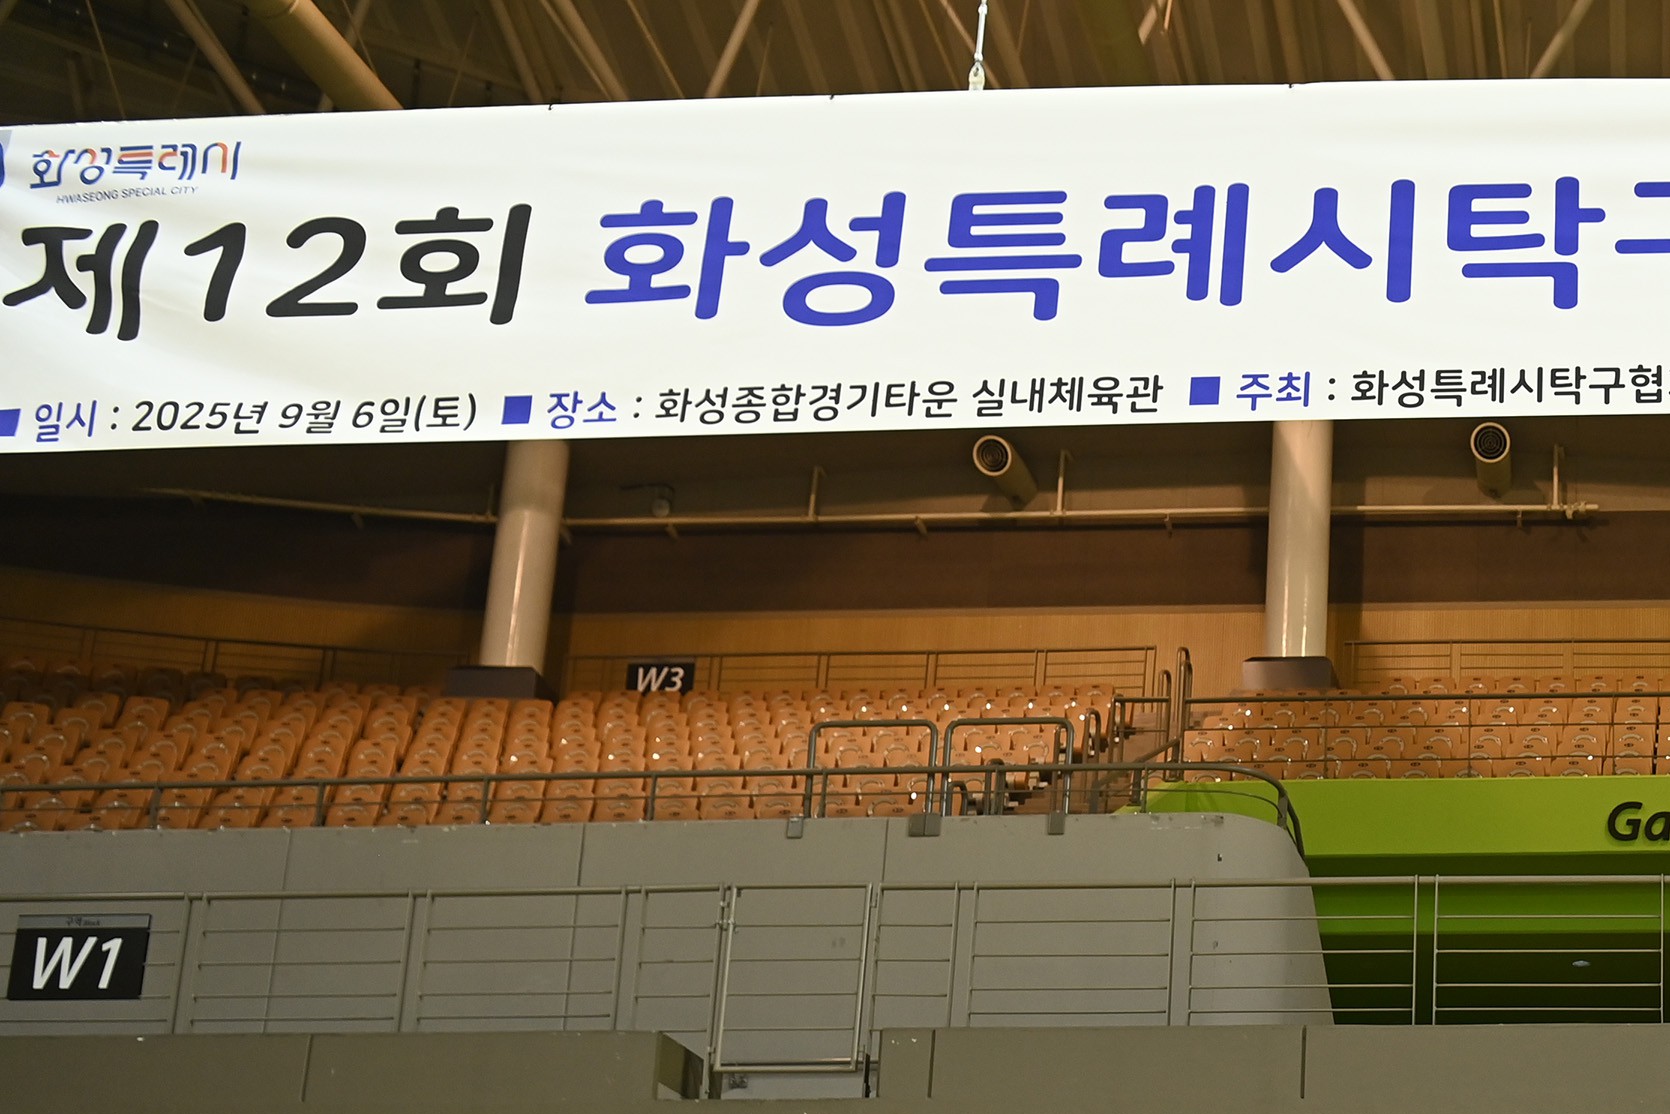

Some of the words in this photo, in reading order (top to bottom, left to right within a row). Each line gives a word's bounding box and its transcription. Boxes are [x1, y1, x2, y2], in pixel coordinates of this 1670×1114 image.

[56, 190, 119, 204] HWASEONG
[121, 186, 167, 199] SPECIAL
[170, 186, 198, 195] CITY
[3, 205, 532, 341] 제12회
[36, 401, 97, 442] 일시
[132, 401, 268, 434] 2025년
[279, 401, 341, 433] 9월
[352, 393, 476, 433] 6일(토)
[550, 392, 616, 429] 장소
[655, 381, 957, 424] 화성종합경기타운
[973, 375, 1163, 417] 실내체육관
[1237, 372, 1310, 411] 주최
[637, 666, 685, 692] W3
[33, 937, 122, 989] W1
